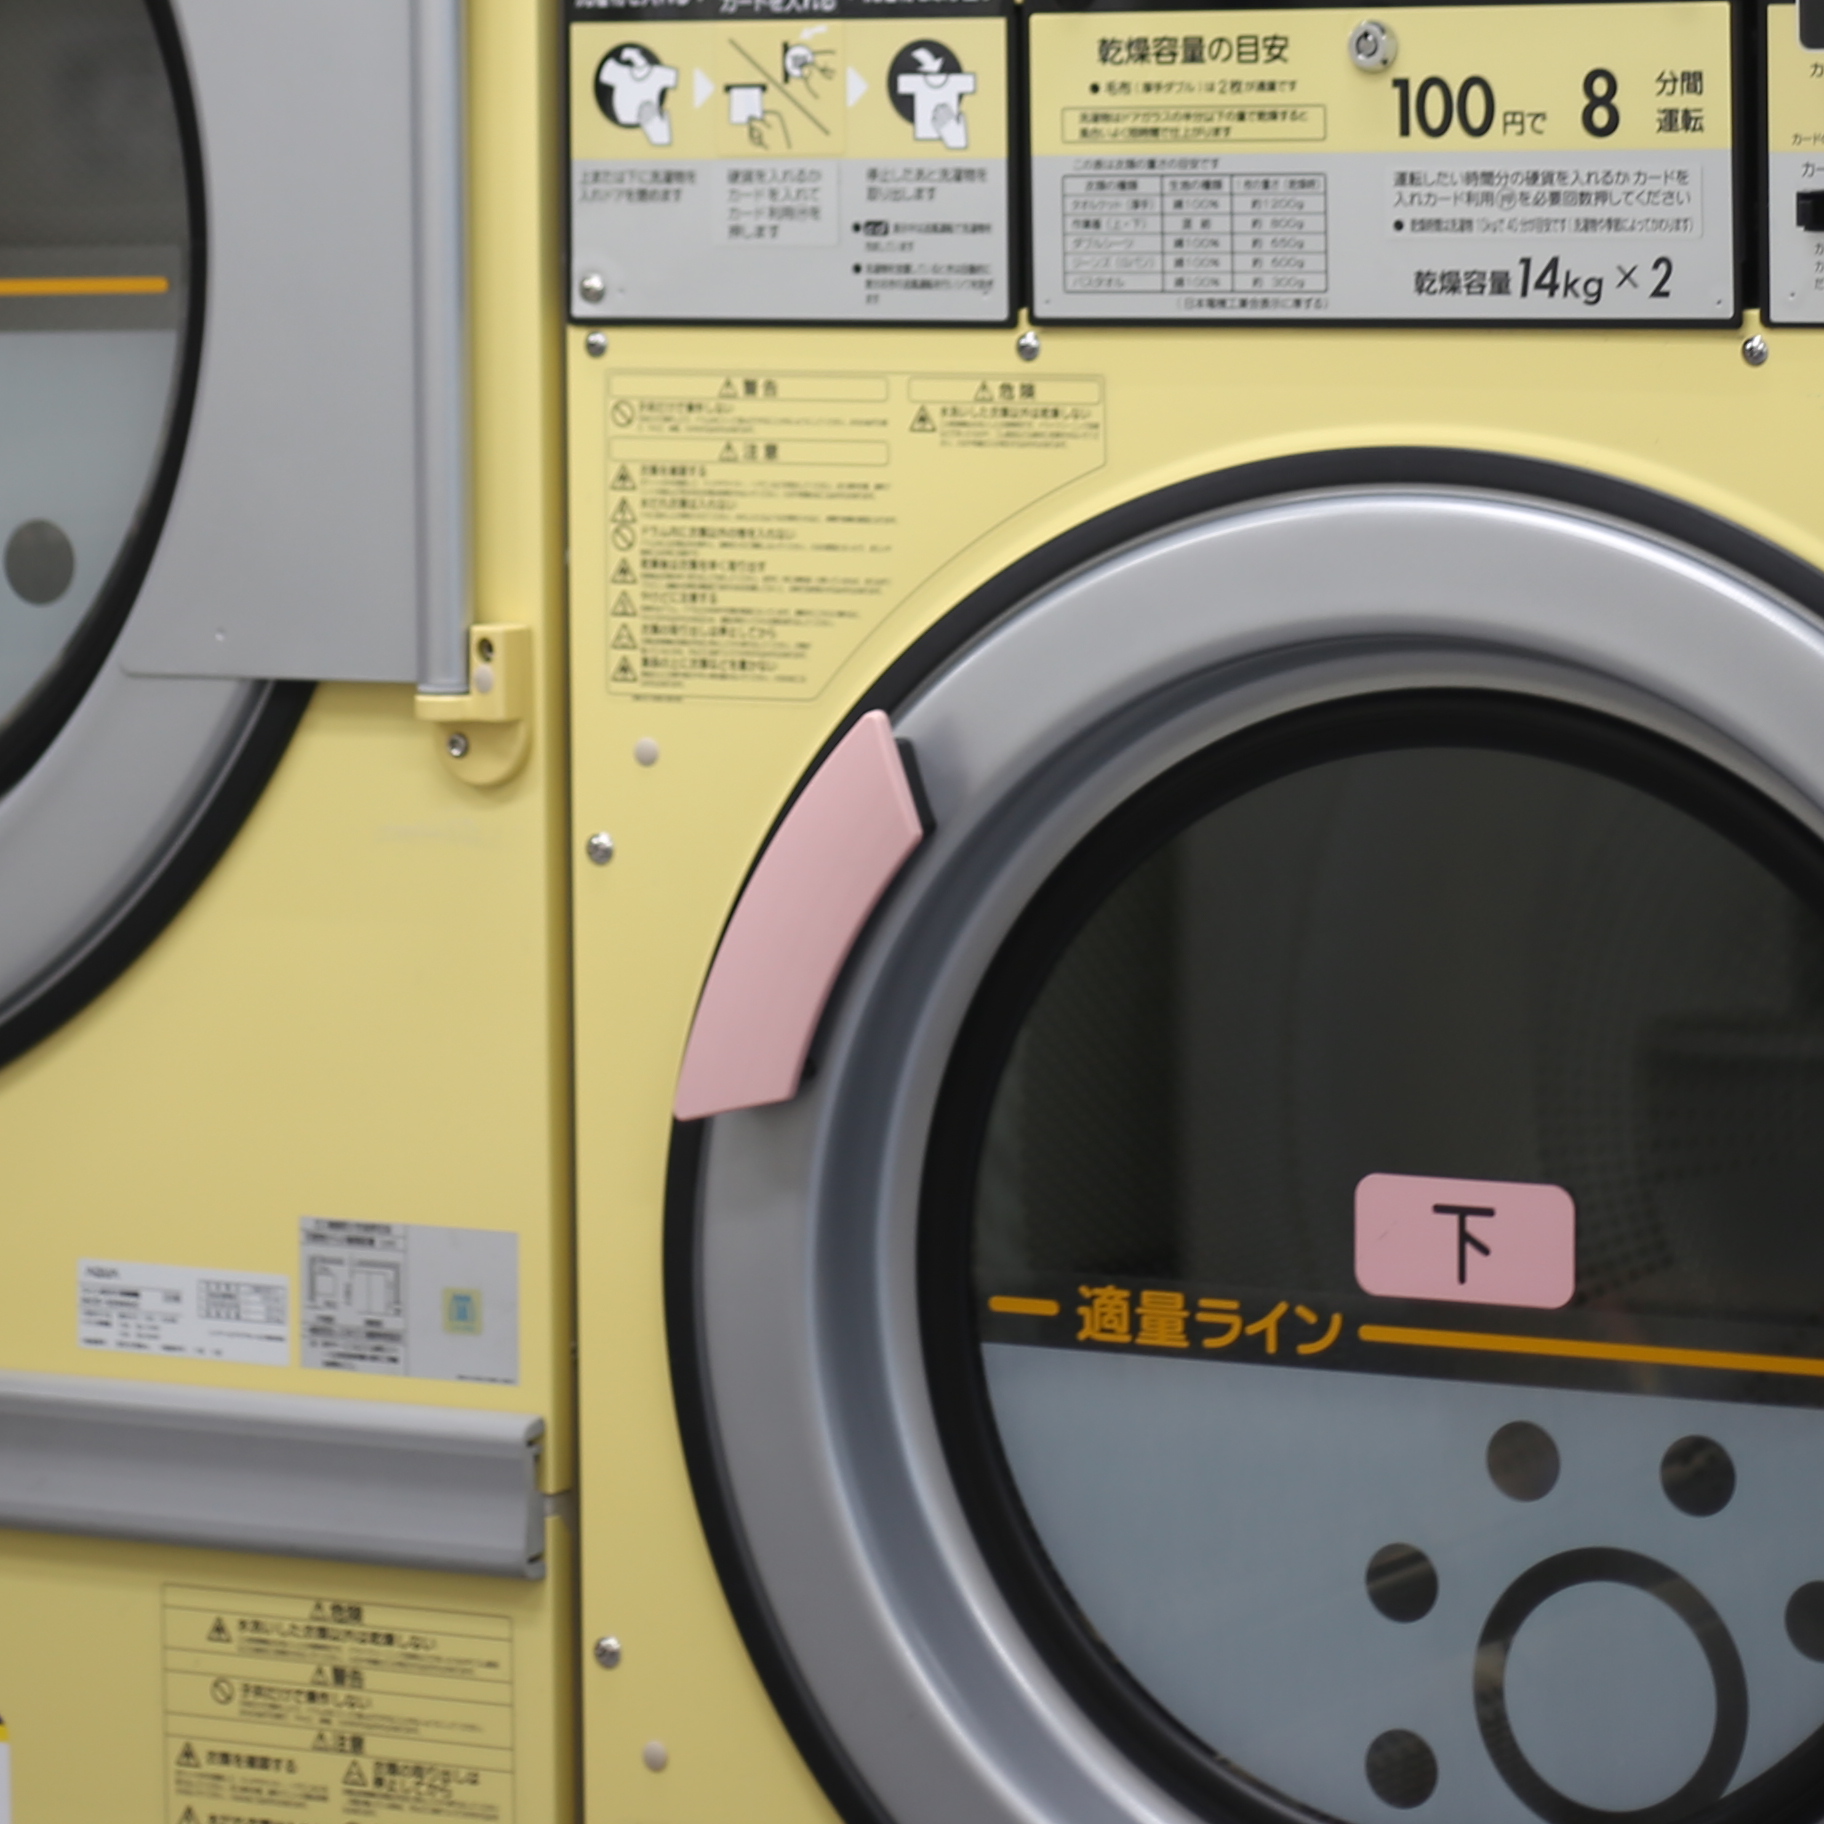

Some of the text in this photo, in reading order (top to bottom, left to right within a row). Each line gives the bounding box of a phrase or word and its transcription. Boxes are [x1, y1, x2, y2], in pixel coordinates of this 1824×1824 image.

[1098, 36, 1290, 65] 乾燥容量の目安
[1581, 68, 1621, 139] 8
[1656, 71, 1704, 97] 分間
[1656, 109, 1704, 134] 運転
[1649, 256, 1673, 298] 2
[1433, 1203, 1495, 1285] 下
[1076, 1285, 1343, 1356] 適量ライン
